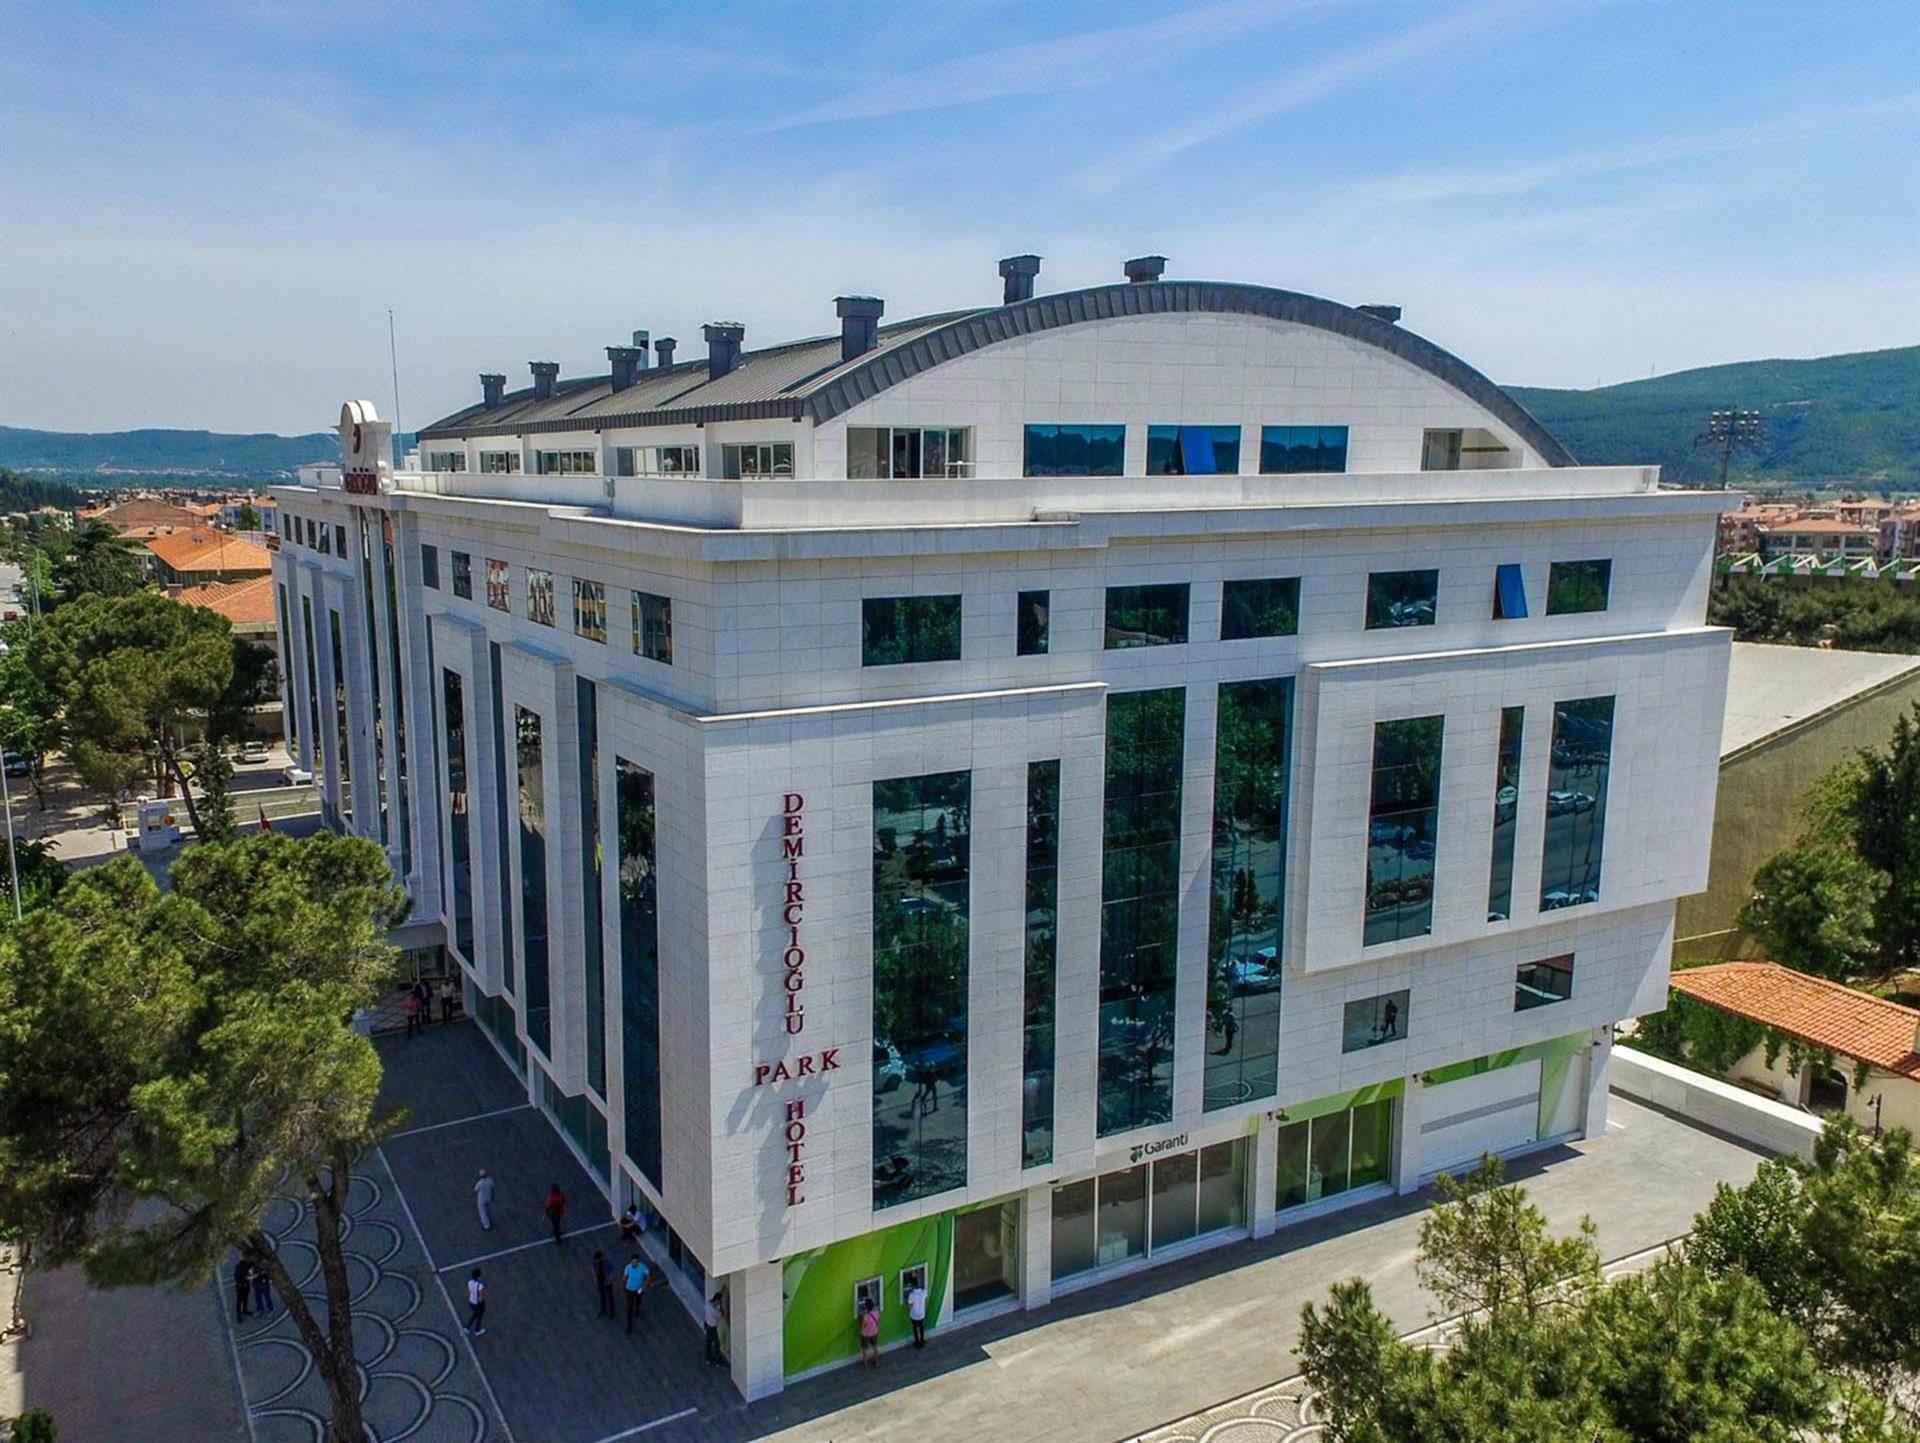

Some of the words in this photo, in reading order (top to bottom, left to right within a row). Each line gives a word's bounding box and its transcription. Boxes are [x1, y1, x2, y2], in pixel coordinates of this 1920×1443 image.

[754, 1049, 840, 1086] PARK
[785, 1100, 805, 1206] HOTEL
[1144, 1132, 1189, 1155] Garanti
